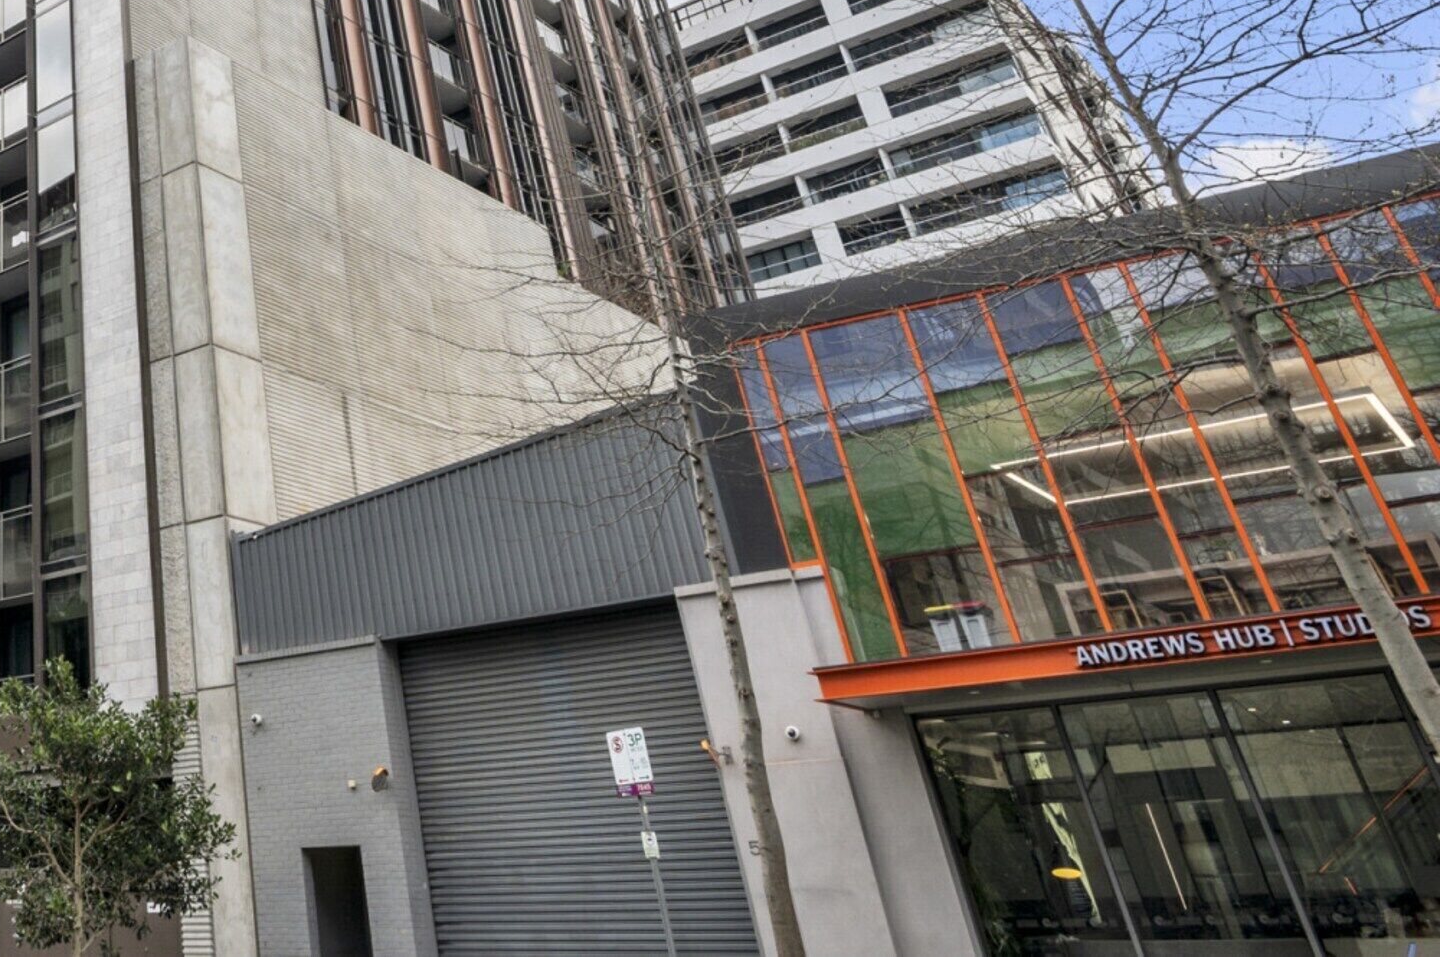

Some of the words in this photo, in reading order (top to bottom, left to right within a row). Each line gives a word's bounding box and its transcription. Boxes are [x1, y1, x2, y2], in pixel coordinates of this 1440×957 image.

[1076, 632, 1205, 667] ANDREWS
[1214, 623, 1276, 650] HUB
[1299, 606, 1431, 641] STUDS
